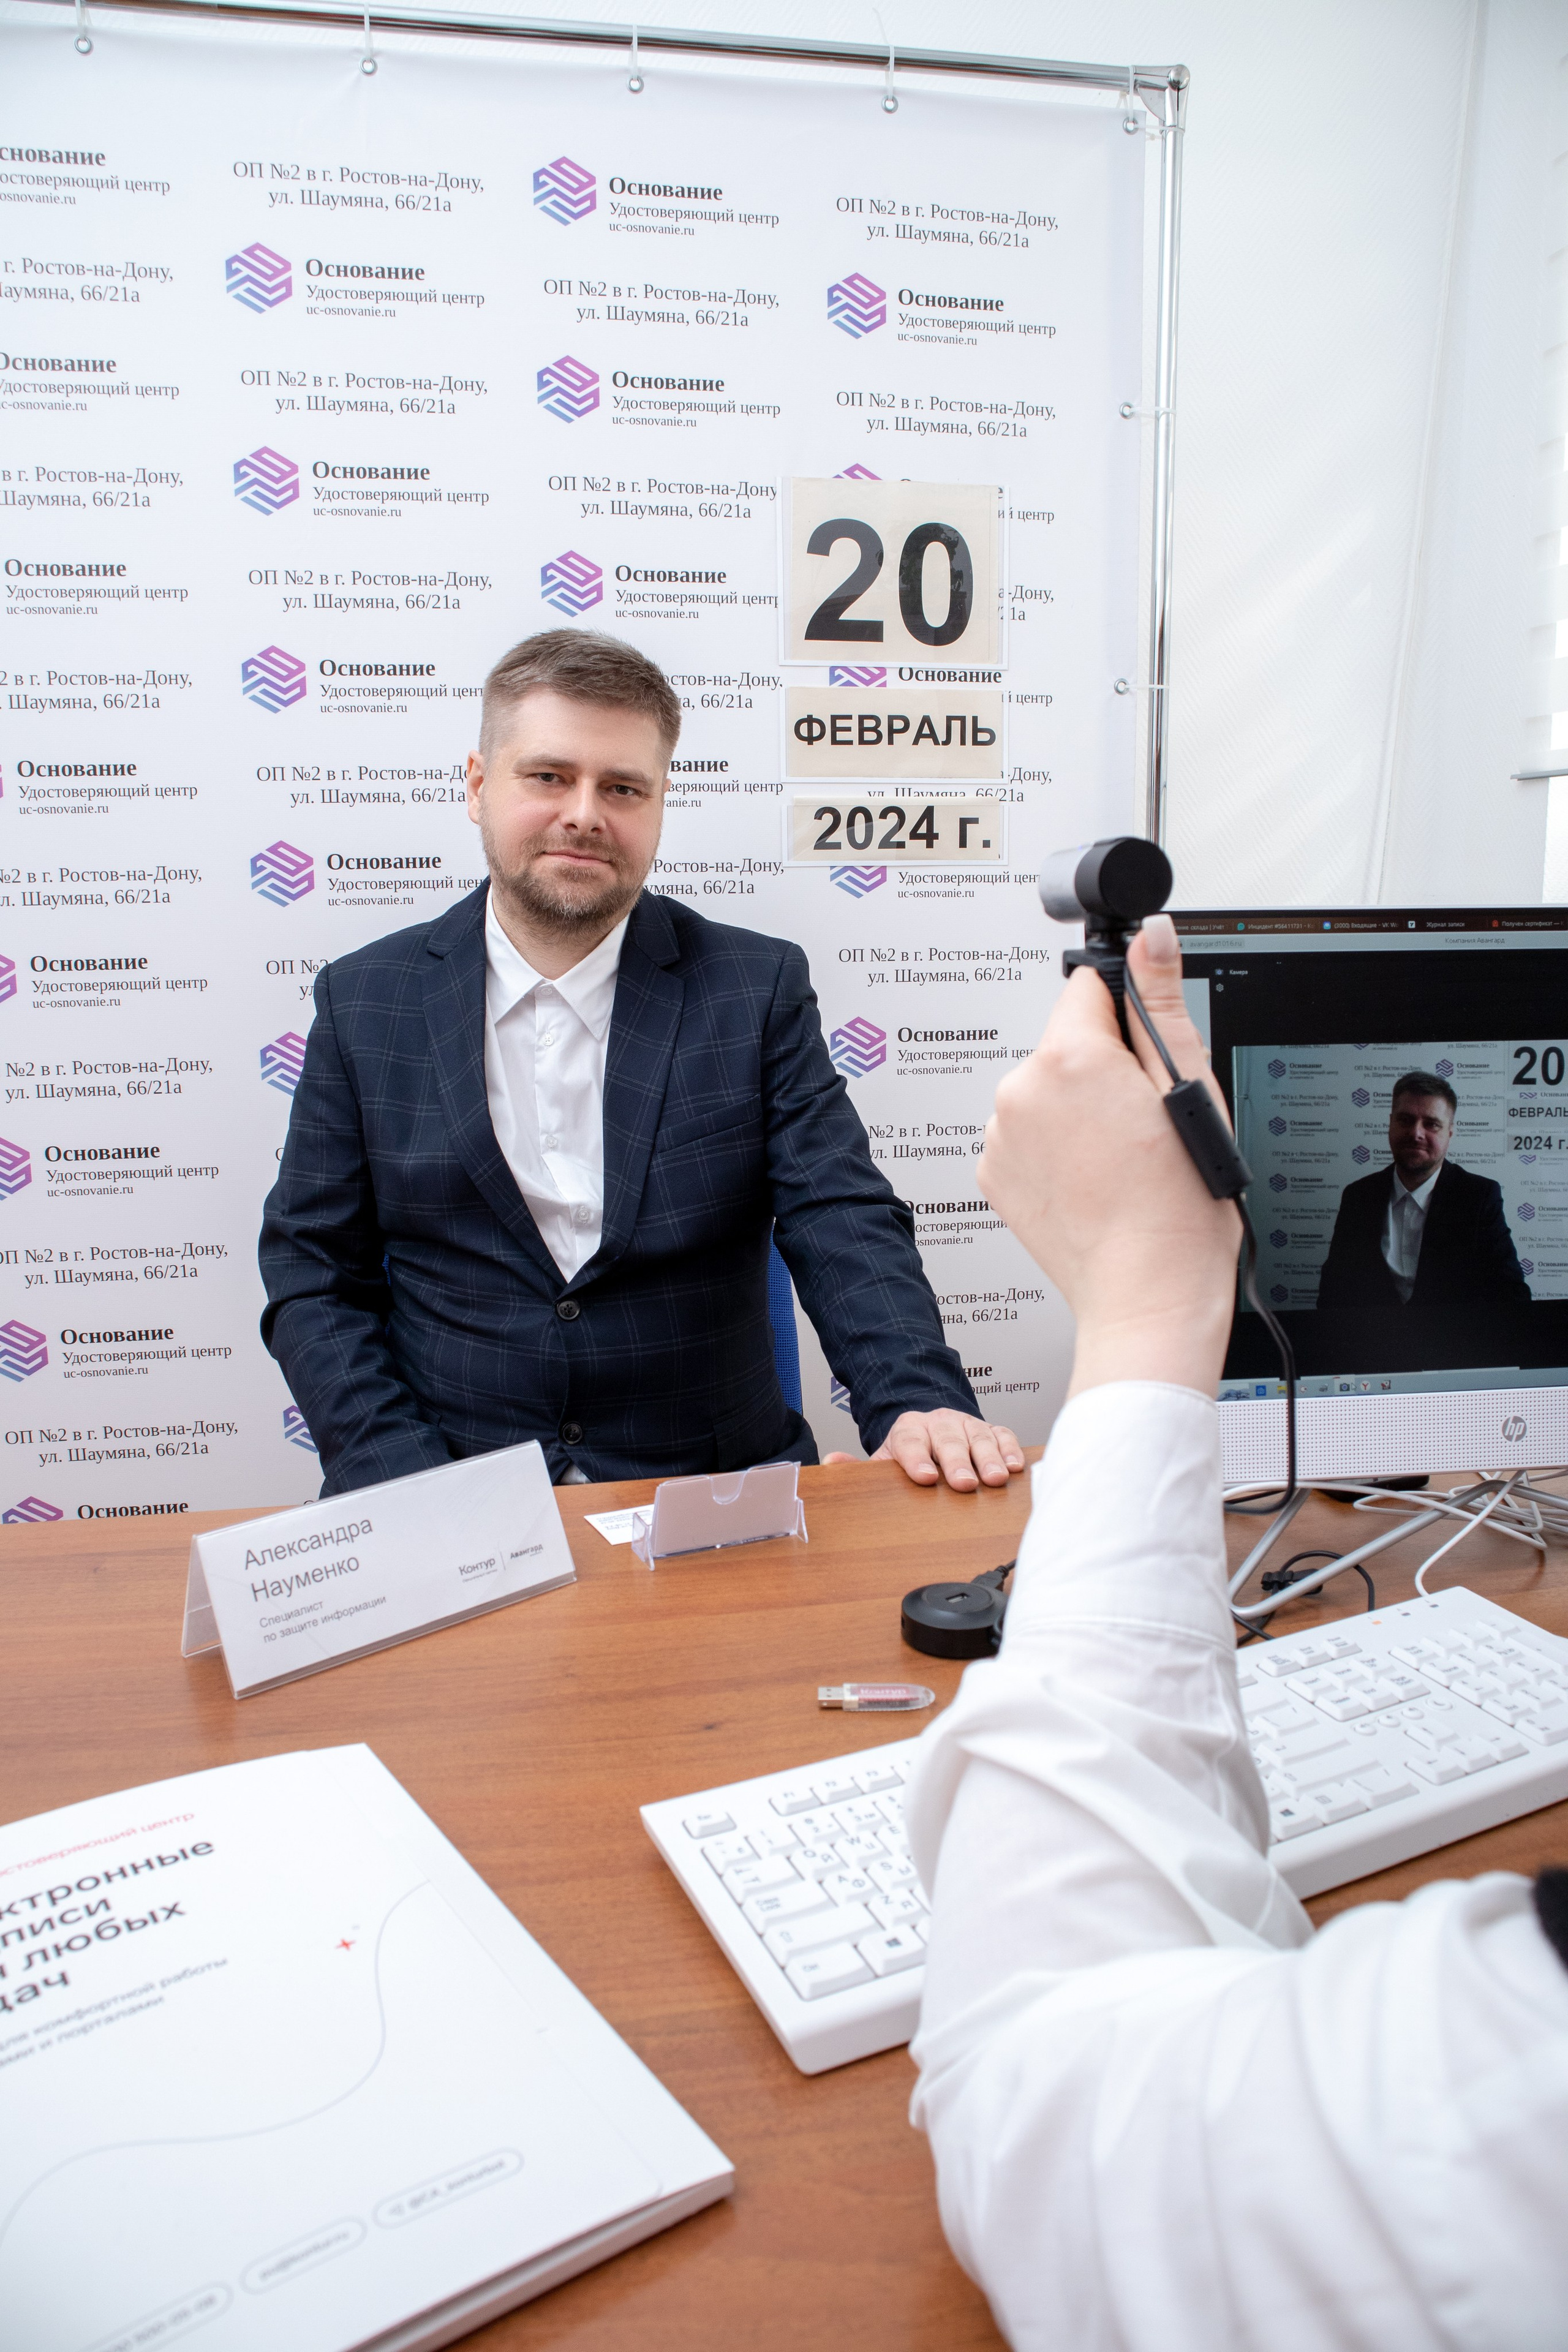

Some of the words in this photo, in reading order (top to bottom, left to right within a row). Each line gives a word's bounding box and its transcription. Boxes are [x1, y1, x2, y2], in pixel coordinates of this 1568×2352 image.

[233, 161, 263, 179] ОП
[270, 163, 301, 181] №2
[306, 169, 317, 181] в
[322, 170, 333, 182] г.
[339, 166, 484, 194] Ростов-на-Дону,
[609, 176, 723, 202] Основание
[268, 192, 293, 209] ул.
[300, 189, 389, 212] Шаумяна,
[395, 194, 451, 213] 66/21а
[609, 202, 734, 225] Удостоверяющий
[739, 213, 779, 228] центр
[836, 197, 863, 214] ОП
[869, 198, 896, 216] №2
[902, 205, 910, 217] в
[915, 206, 925, 218] г.
[930, 203, 1058, 232] Ростов-на-Дону,
[609, 223, 695, 236] uc-osnovanie.ru
[867, 225, 889, 241] ул.
[895, 224, 973, 247] Шаумяна,
[979, 230, 1029, 248] 66/21а
[306, 258, 425, 281] Основание
[306, 284, 437, 306] Удостоверяющий
[442, 293, 485, 309] центр
[544, 279, 573, 296] ОП
[579, 280, 607, 297] №2
[612, 285, 622, 298] в
[627, 287, 637, 298] г.
[644, 284, 779, 310] Ростов-на-Дону,
[898, 288, 1004, 312] Основание
[306, 306, 396, 318] uc-osnovanie.ru
[576, 307, 600, 324] ул.
[606, 304, 690, 326] Шаумяна,
[695, 309, 748, 327] 66/21а
[898, 312, 1014, 335] Удостоверяющий
[1019, 323, 1056, 339] центр
[897, 333, 977, 346] uc-osnovanie.ru
[612, 371, 725, 392] Основание
[612, 396, 736, 416] Удостоверяющий
[740, 404, 781, 419] центр
[612, 416, 696, 428] uc-osnovanie.ru
[1, 469, 12, 481] в
[17, 470, 29, 482] г.
[35, 466, 183, 488] Ростов-на-Дону,
[312, 461, 431, 481] Основание
[312, 486, 442, 505] Удостоверяющий
[447, 492, 489, 507] центр
[313, 505, 402, 518] uc-osnovanie.ru
[4, 559, 127, 578] Основание
[615, 565, 727, 584] Основание
[804, 518, 974, 647] 20
[6, 584, 140, 602] Удостоверяющий
[144, 588, 189, 603] центр
[615, 589, 737, 607] Удостоверяющий
[6, 603, 98, 616] uc-osnovanie.ru
[615, 608, 699, 619] uc-osnovanie.ru
[898, 666, 1002, 684] Основание
[793, 714, 997, 747] ФЕВРАЛЬ
[17, 760, 137, 778] Основание
[18, 783, 150, 802] Удостоверяющий
[154, 786, 198, 800] центр
[19, 803, 109, 815] uc-osnovanie.ru
[812, 805, 939, 851] 2024
[959, 816, 992, 850] г.
[653, 856, 784, 876] Ростов-на-Дону,
[703, 880, 755, 895] 66/21а
[898, 870, 1010, 887] Удостоверяющий
[898, 888, 974, 899] uc-osnovanie.ru
[30, 955, 148, 973] Основание
[839, 948, 865, 963] ОП
[870, 948, 895, 962] №2
[901, 951, 909, 962] в
[914, 951, 923, 962] г.
[928, 946, 1050, 964] Ростов-на-Дону,
[31, 976, 161, 996] Удостоверяющий
[165, 978, 208, 993] центр
[867, 973, 889, 987] ул.
[894, 968, 969, 986] Шаумяна,
[974, 967, 1022, 982] 66/21а
[32, 997, 121, 1009] uc-osnovanie.ru
[897, 1027, 998, 1043] Основание
[897, 1046, 1008, 1064] Удостоверяющий
[6, 1061, 36, 1077] №2
[40, 1065, 50, 1077] в
[55, 1064, 66, 1076] г.
[72, 1057, 213, 1077] Ростов-на-Дону,
[897, 1064, 972, 1076] uc-osnovanie.ru
[1512, 1046, 1566, 1086] 20
[5, 1088, 29, 1104] ул.
[35, 1083, 121, 1102] Шаумяна,
[127, 1079, 182, 1096] 66/21а
[1513, 1136, 1553, 1150] 2024
[935, 1287, 1045, 1305] остов-на-Дону,
[972, 1308, 1018, 1323] 66/21а
[60, 1328, 174, 1346] Основание
[62, 1346, 187, 1367] Удостоверяющий
[190, 1347, 232, 1360] центр
[63, 1365, 149, 1379] uc-osnovanie.ru
[1005, 1381, 1040, 1395] центр
[5, 1430, 34, 1446] ОП
[38, 1428, 67, 1444] №2
[72, 1431, 82, 1441] в
[87, 1430, 97, 1441] г.
[102, 1420, 238, 1440] Ростов-на-Дону,
[1503, 1415, 1526, 1442] hp
[39, 1452, 62, 1468] ул.
[67, 1447, 151, 1465] Шаумяна,
[156, 1441, 209, 1457] 66/21а
[77, 1502, 189, 1520] Основание
[244, 1519, 374, 1570] Александра
[510, 1544, 544, 1559] Авангард
[458, 1558, 496, 1576] Контур
[251, 1557, 360, 1602] Науменко
[259, 1600, 324, 1628] Специалист
[263, 1632, 277, 1643] по
[279, 1619, 318, 1639] защите
[321, 1596, 386, 1624] информации
[22, 1901, 186, 1971] любых
